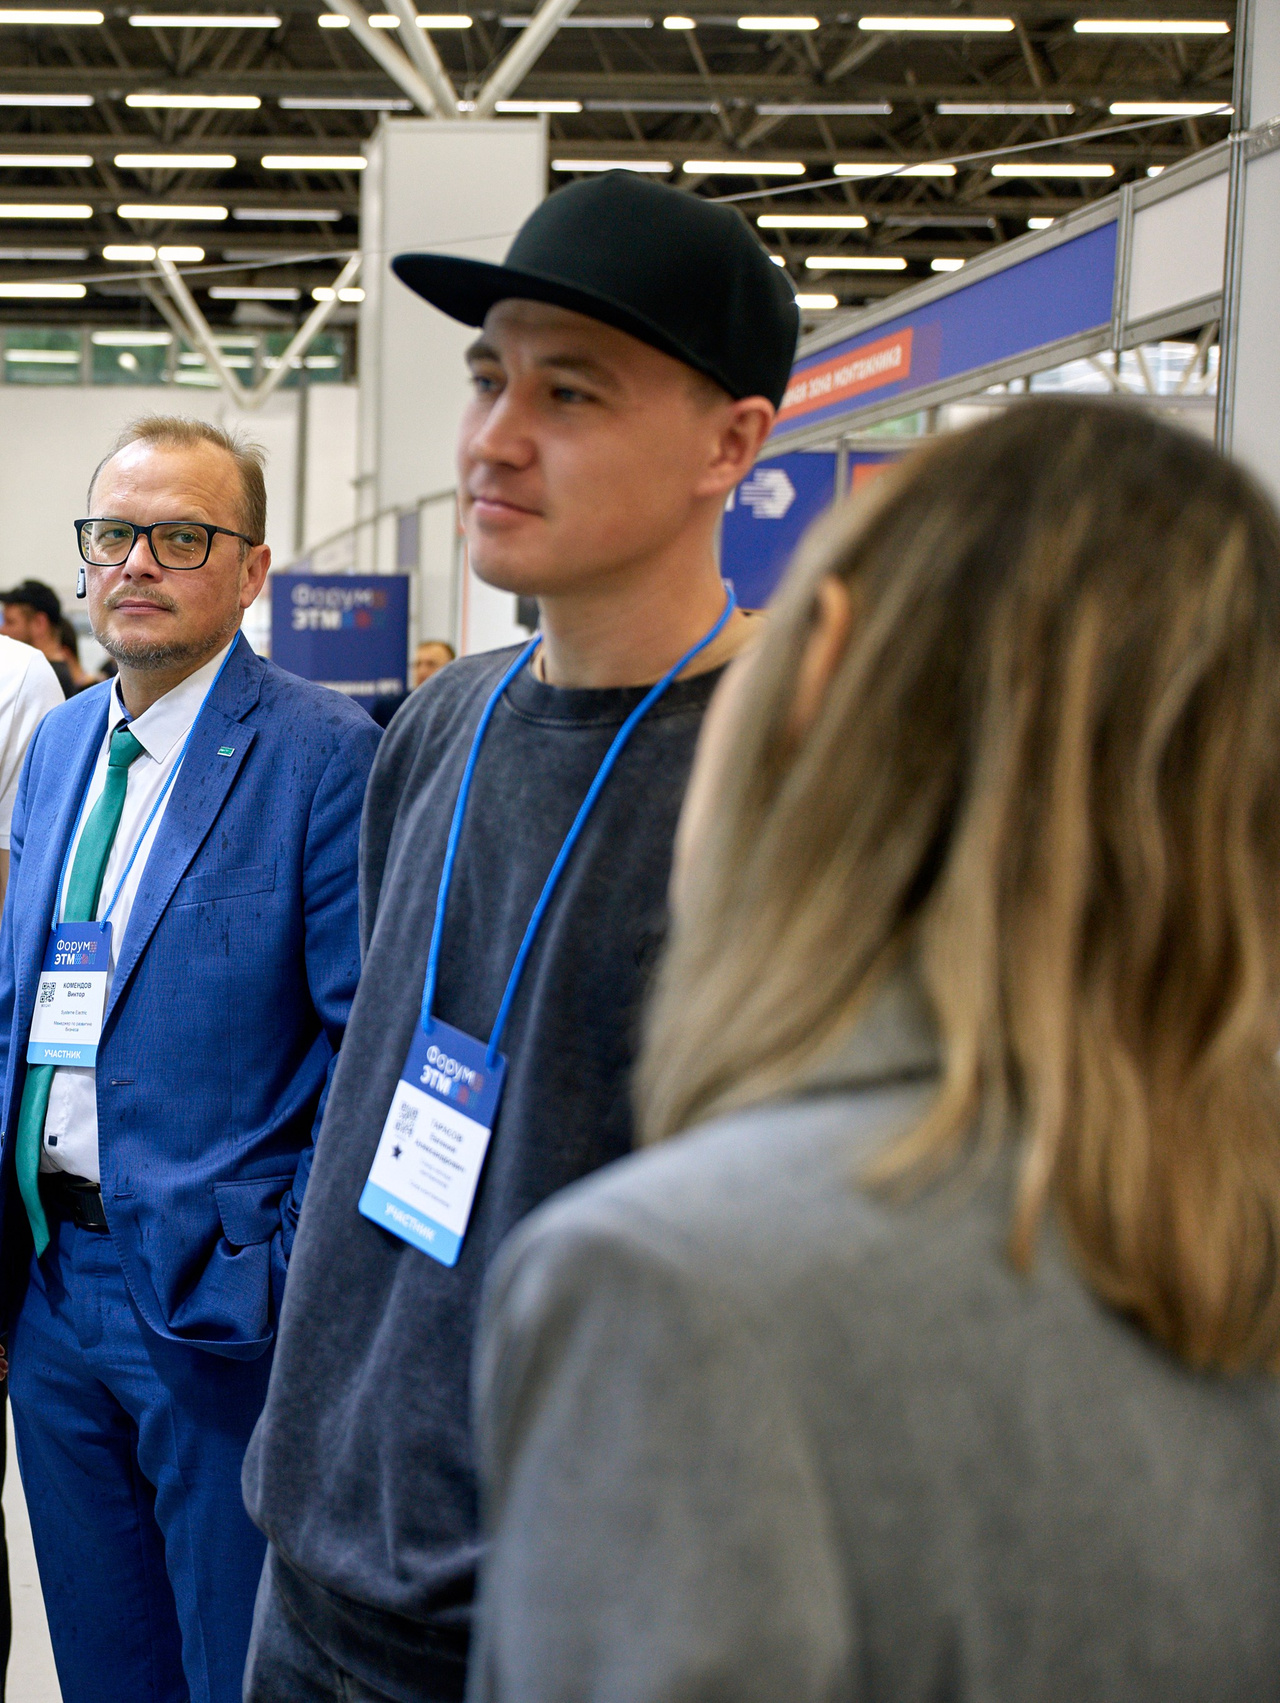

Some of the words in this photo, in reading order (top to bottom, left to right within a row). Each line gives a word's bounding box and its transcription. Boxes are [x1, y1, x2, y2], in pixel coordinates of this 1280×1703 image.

[291, 606, 342, 631] ЭТМ
[56, 939, 90, 953] Форум
[54, 953, 75, 965] ЭТМ
[63, 982, 92, 990] КОМЕНДОВ
[67, 990, 86, 998] Виктор
[44, 1049, 81, 1059] УЧАСТНИК
[426, 1044, 476, 1087] Форум
[419, 1064, 452, 1096] ЭТМ
